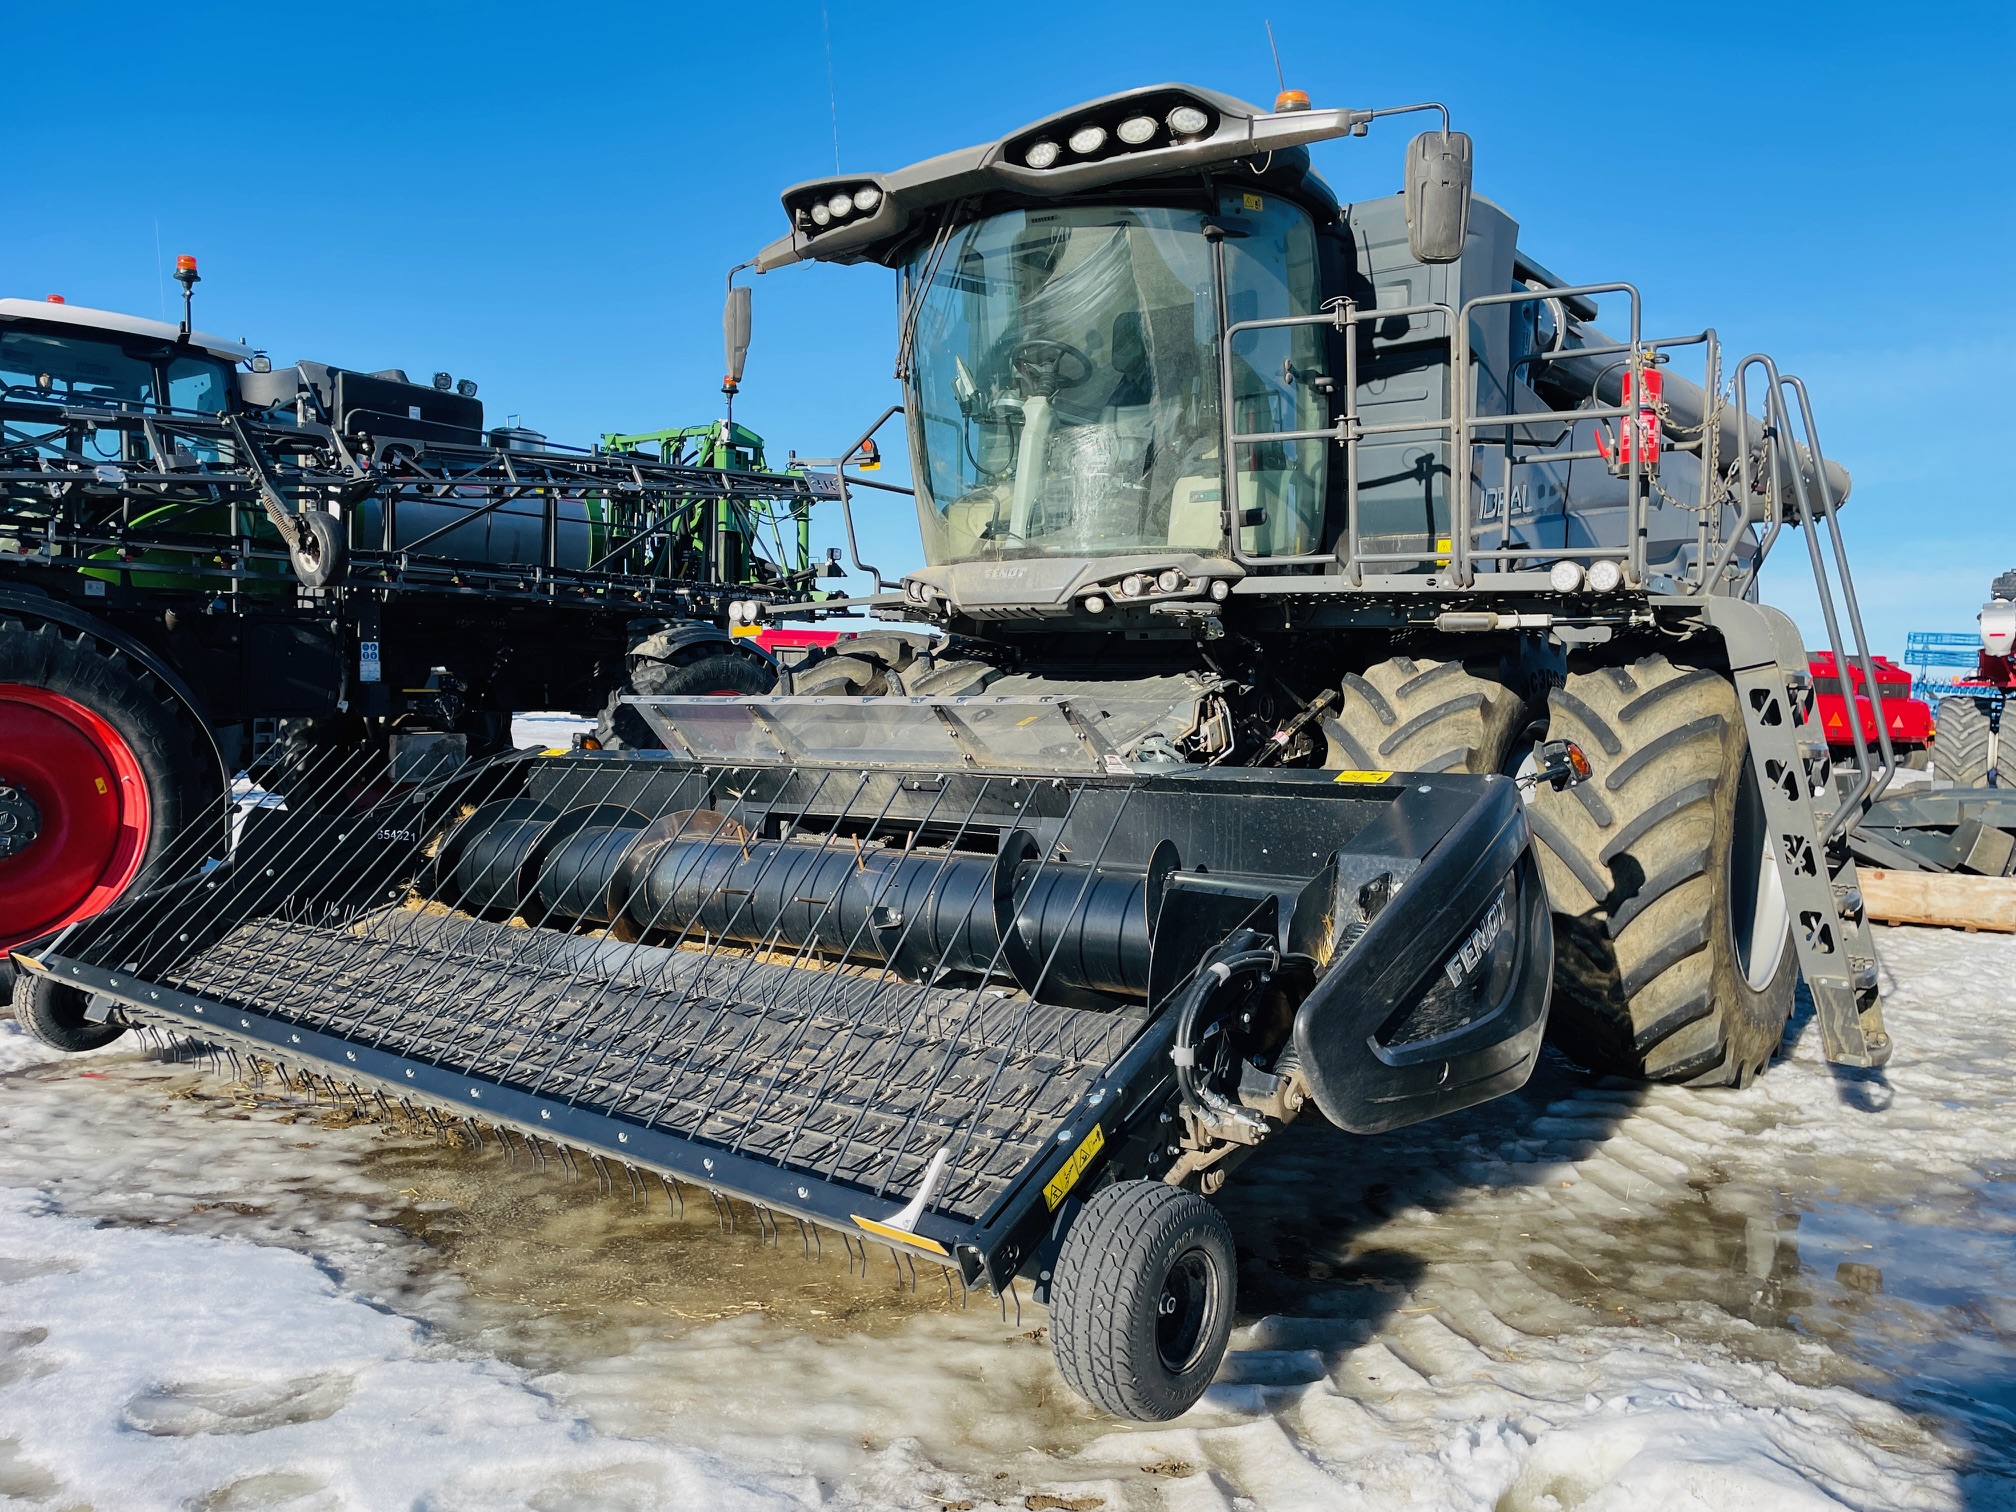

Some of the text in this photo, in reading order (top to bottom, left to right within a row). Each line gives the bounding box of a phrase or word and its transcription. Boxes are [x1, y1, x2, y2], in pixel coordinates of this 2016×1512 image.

[1478, 484, 1532, 519] IDEAL
[985, 567, 1028, 579] FENDT
[377, 829, 416, 844] 654321
[1444, 887, 1507, 988] FENDT
